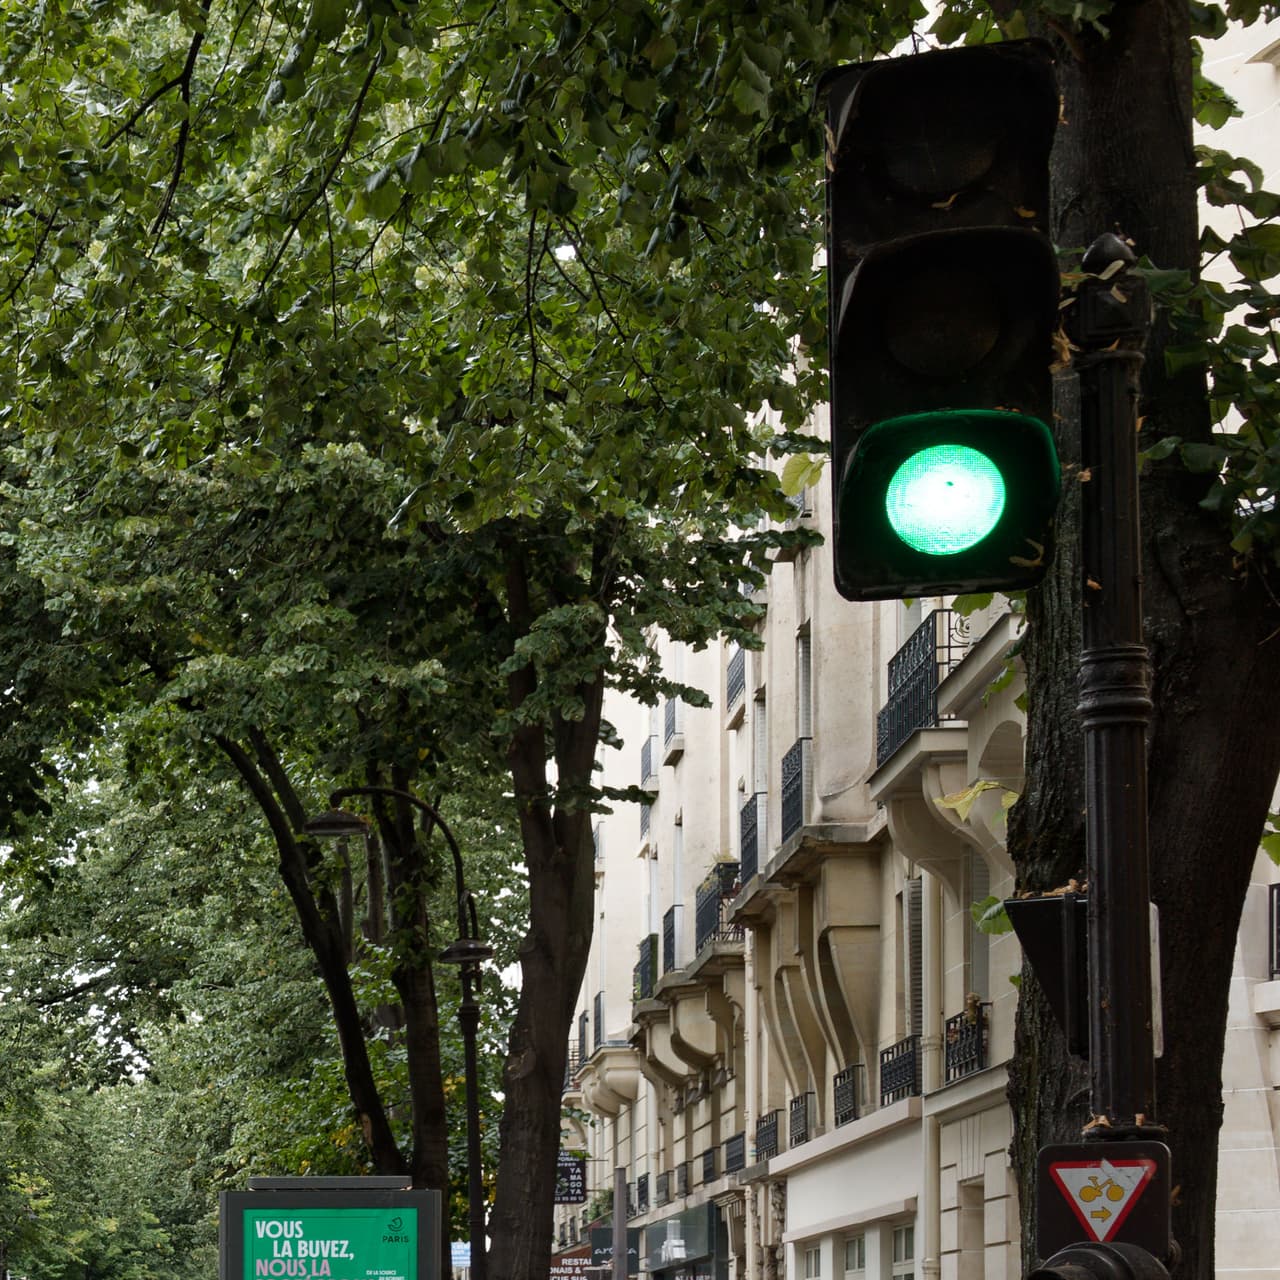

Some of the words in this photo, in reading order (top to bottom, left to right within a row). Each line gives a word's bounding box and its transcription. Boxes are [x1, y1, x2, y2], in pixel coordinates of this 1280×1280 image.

[255, 1220, 304, 1239] VOUS
[382, 1235, 409, 1243] PARIS
[273, 1240, 293, 1258] LA
[297, 1240, 354, 1261] BUVEZ,
[255, 1259, 307, 1277] NOUS
[311, 1259, 331, 1277] LA
